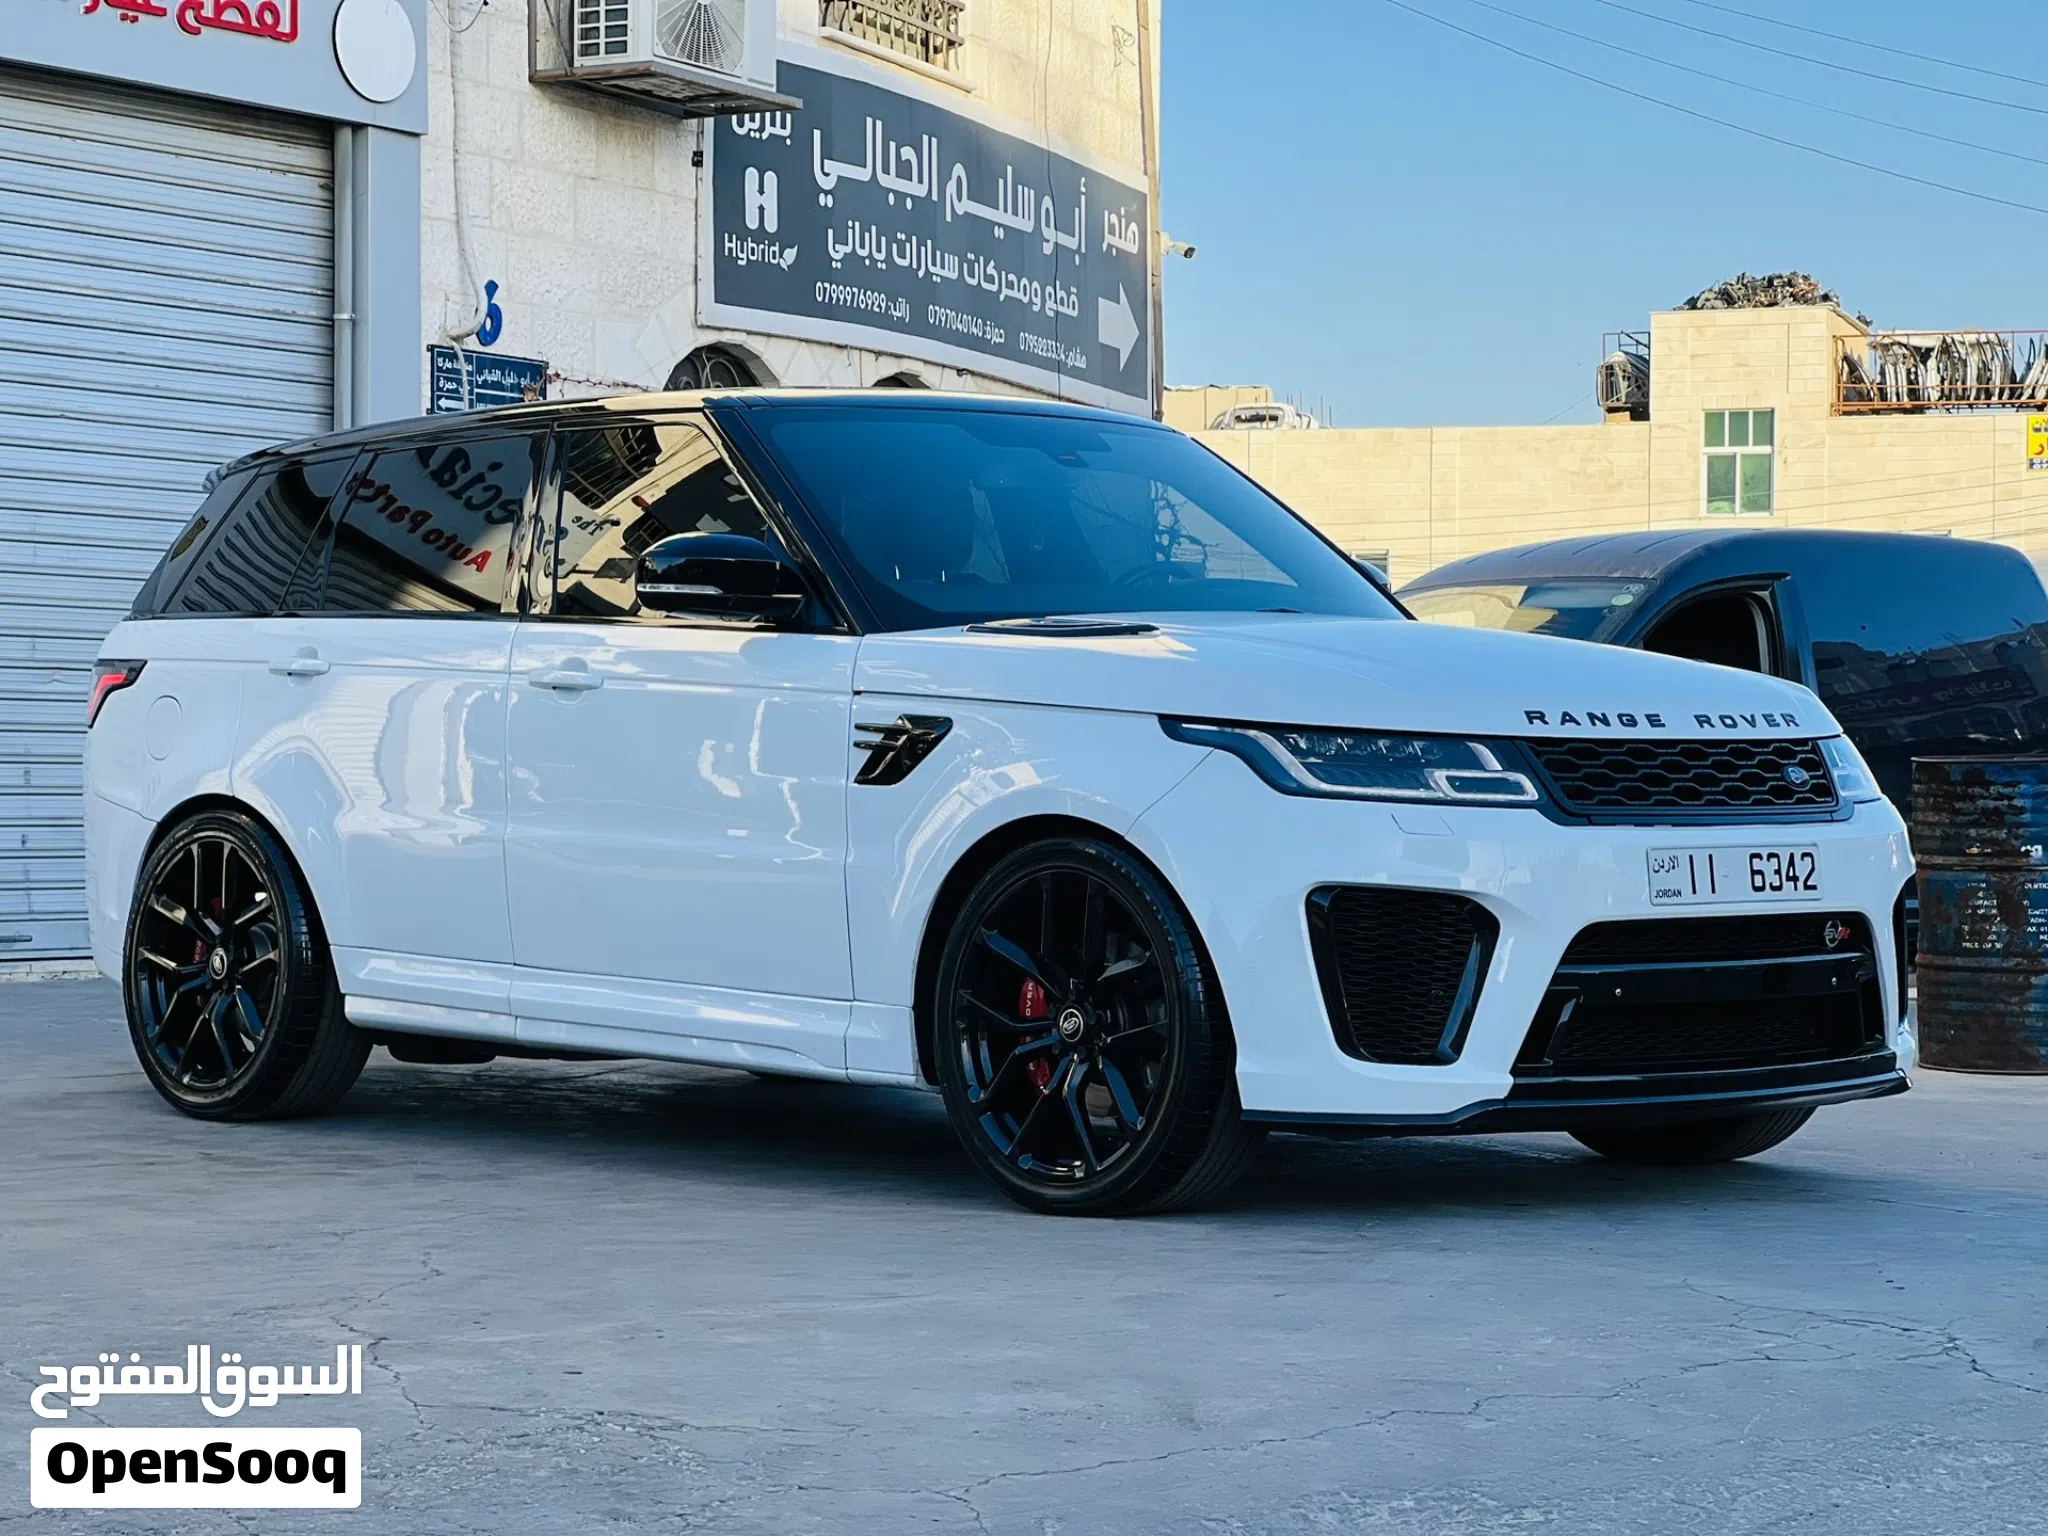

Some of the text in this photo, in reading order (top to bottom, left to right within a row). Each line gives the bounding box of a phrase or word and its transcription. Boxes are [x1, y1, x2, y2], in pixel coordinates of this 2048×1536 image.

[813, 116, 938, 211] الجبالي
[945, 162, 1035, 240] سليم
[1041, 177, 1087, 266] أبو
[724, 233, 780, 266] Hybrid
[827, 220, 1079, 318] قطع ومحركات سيارات ياباني
[815, 281, 886, 313] 0799976929
[928, 304, 983, 338] 0797040140
[1524, 709, 1801, 729] RANGE ROVER
[1749, 851, 1819, 893] 6342
[1654, 888, 1682, 899] JORDAN
